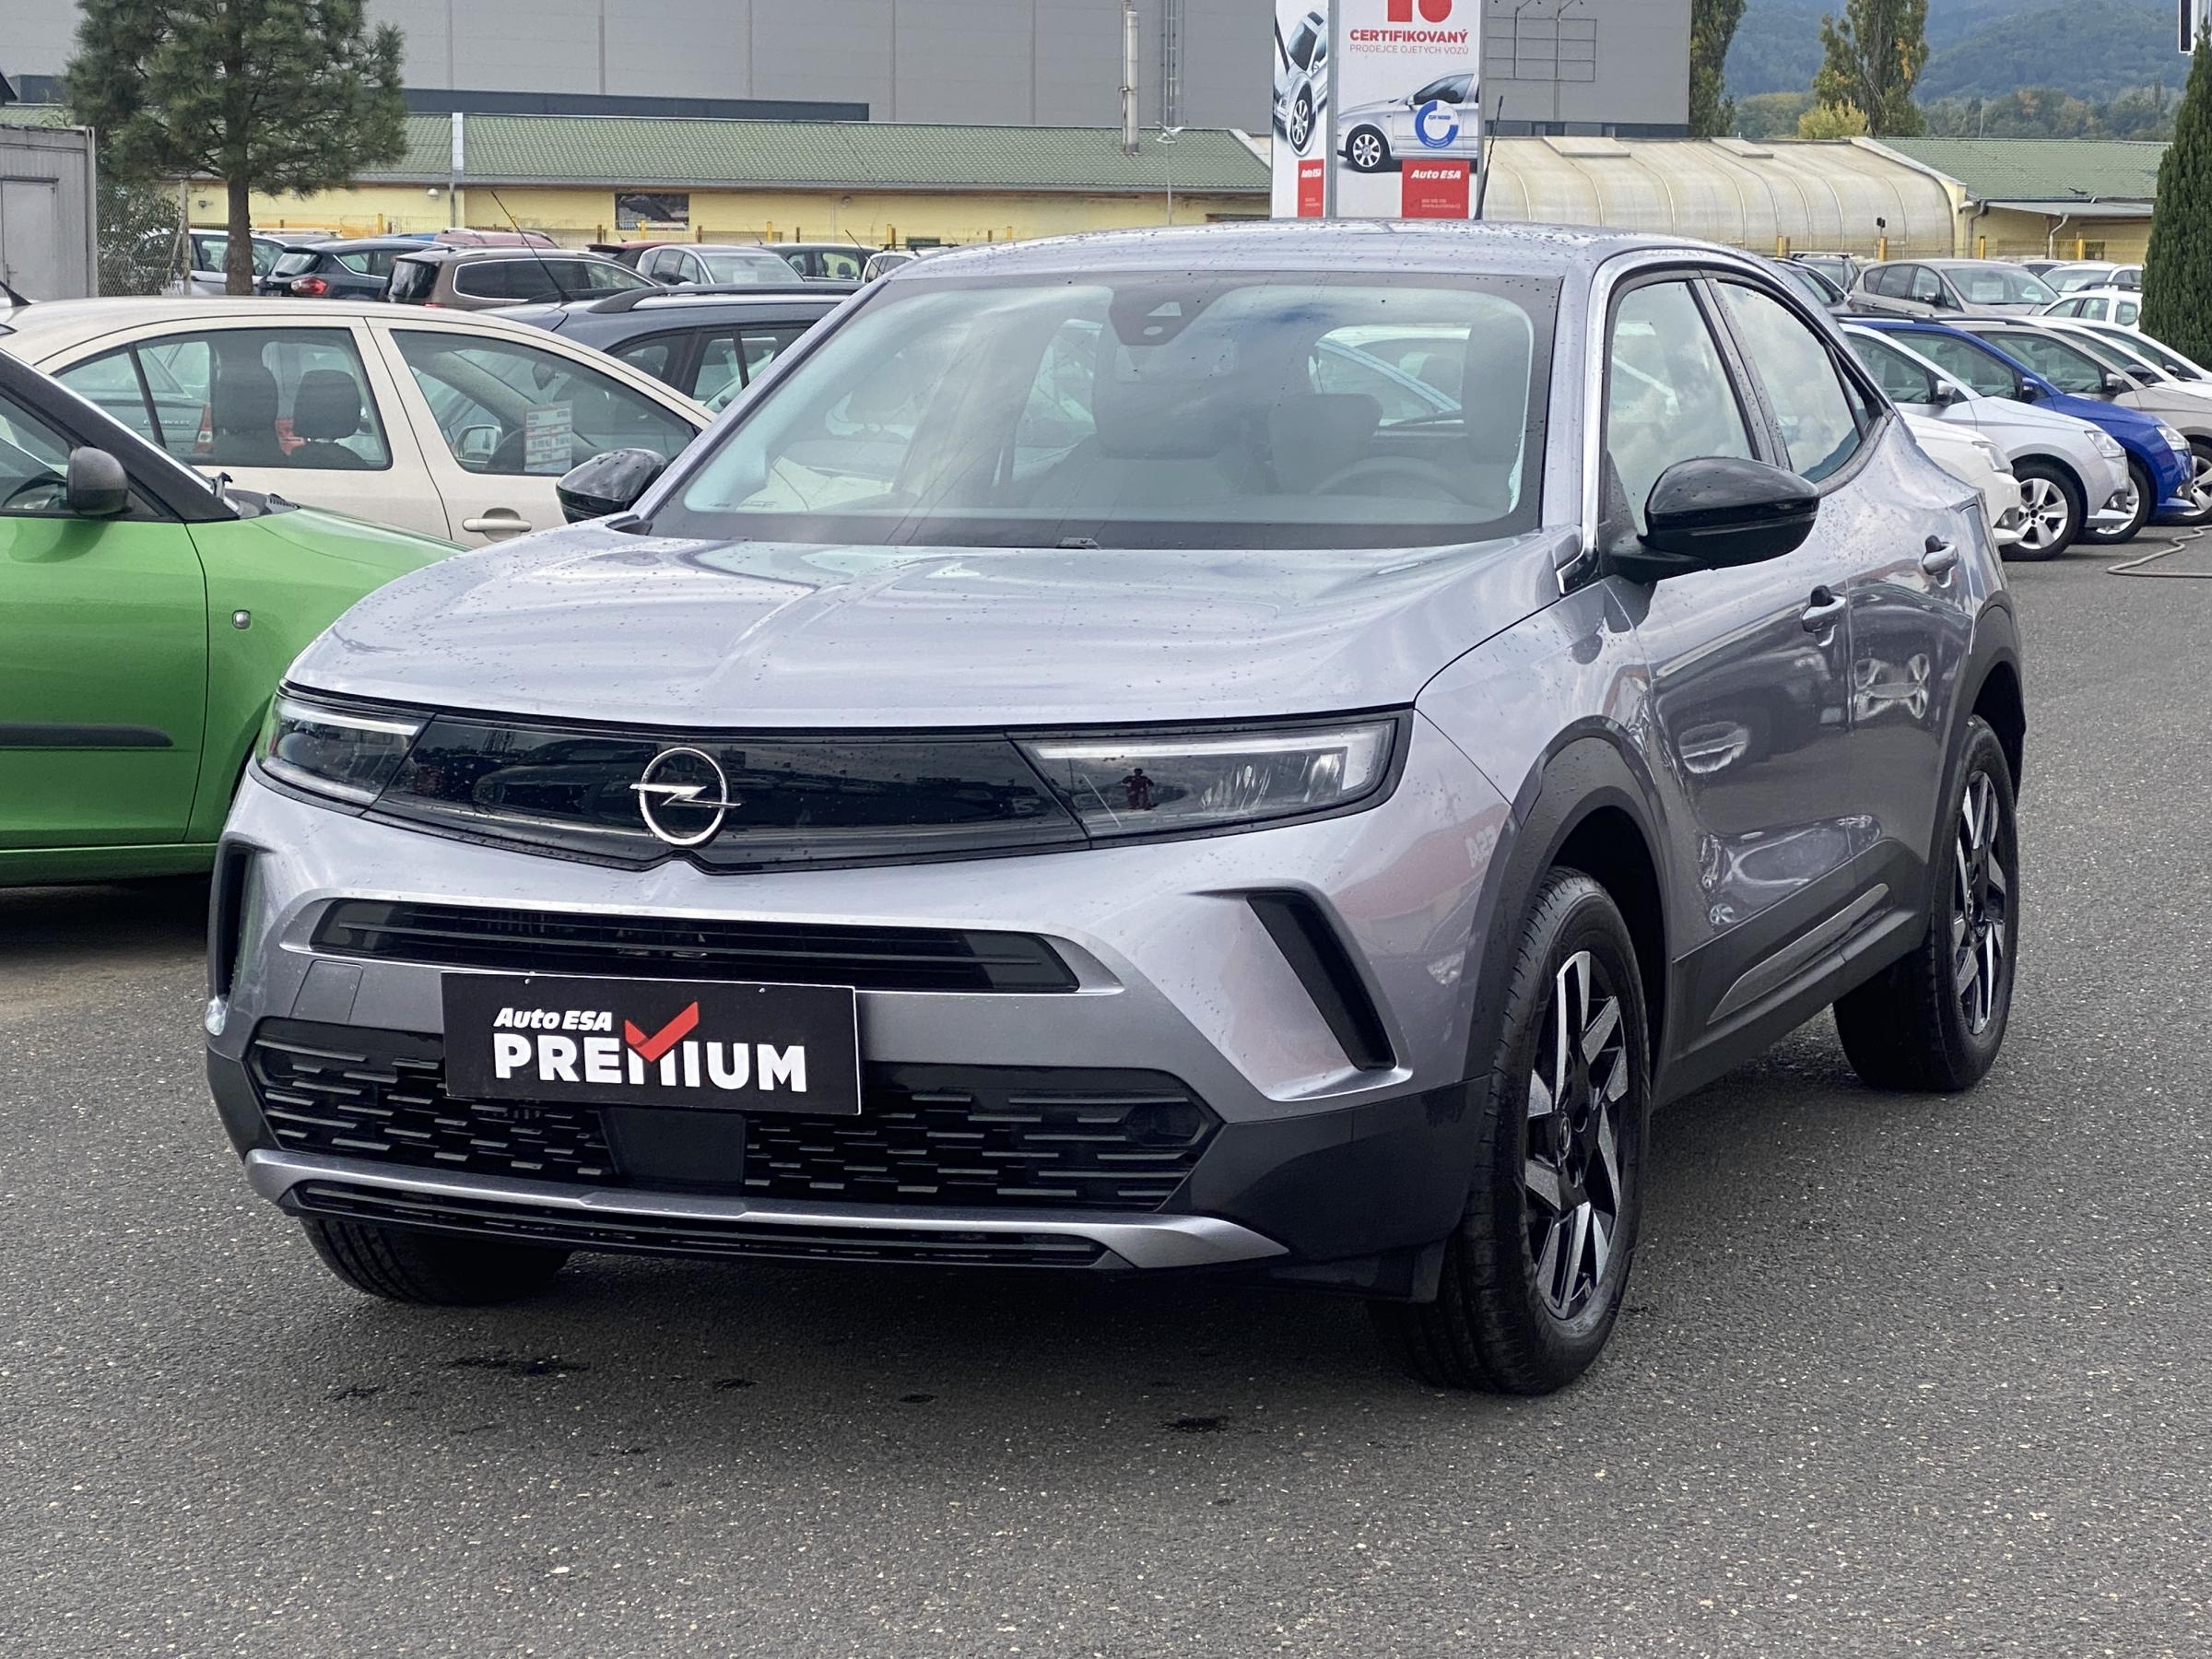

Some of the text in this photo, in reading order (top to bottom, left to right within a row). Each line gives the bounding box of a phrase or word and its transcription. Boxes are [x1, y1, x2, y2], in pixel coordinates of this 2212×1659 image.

[1349, 29, 1468, 43] CERTIFIKOVANÝ
[1349, 44, 1398, 53] PRODEJCE
[1411, 170, 1462, 180] Auto ESA
[493, 1006, 613, 1032] Auto ESA
[492, 1031, 808, 1093] PREMIUM
